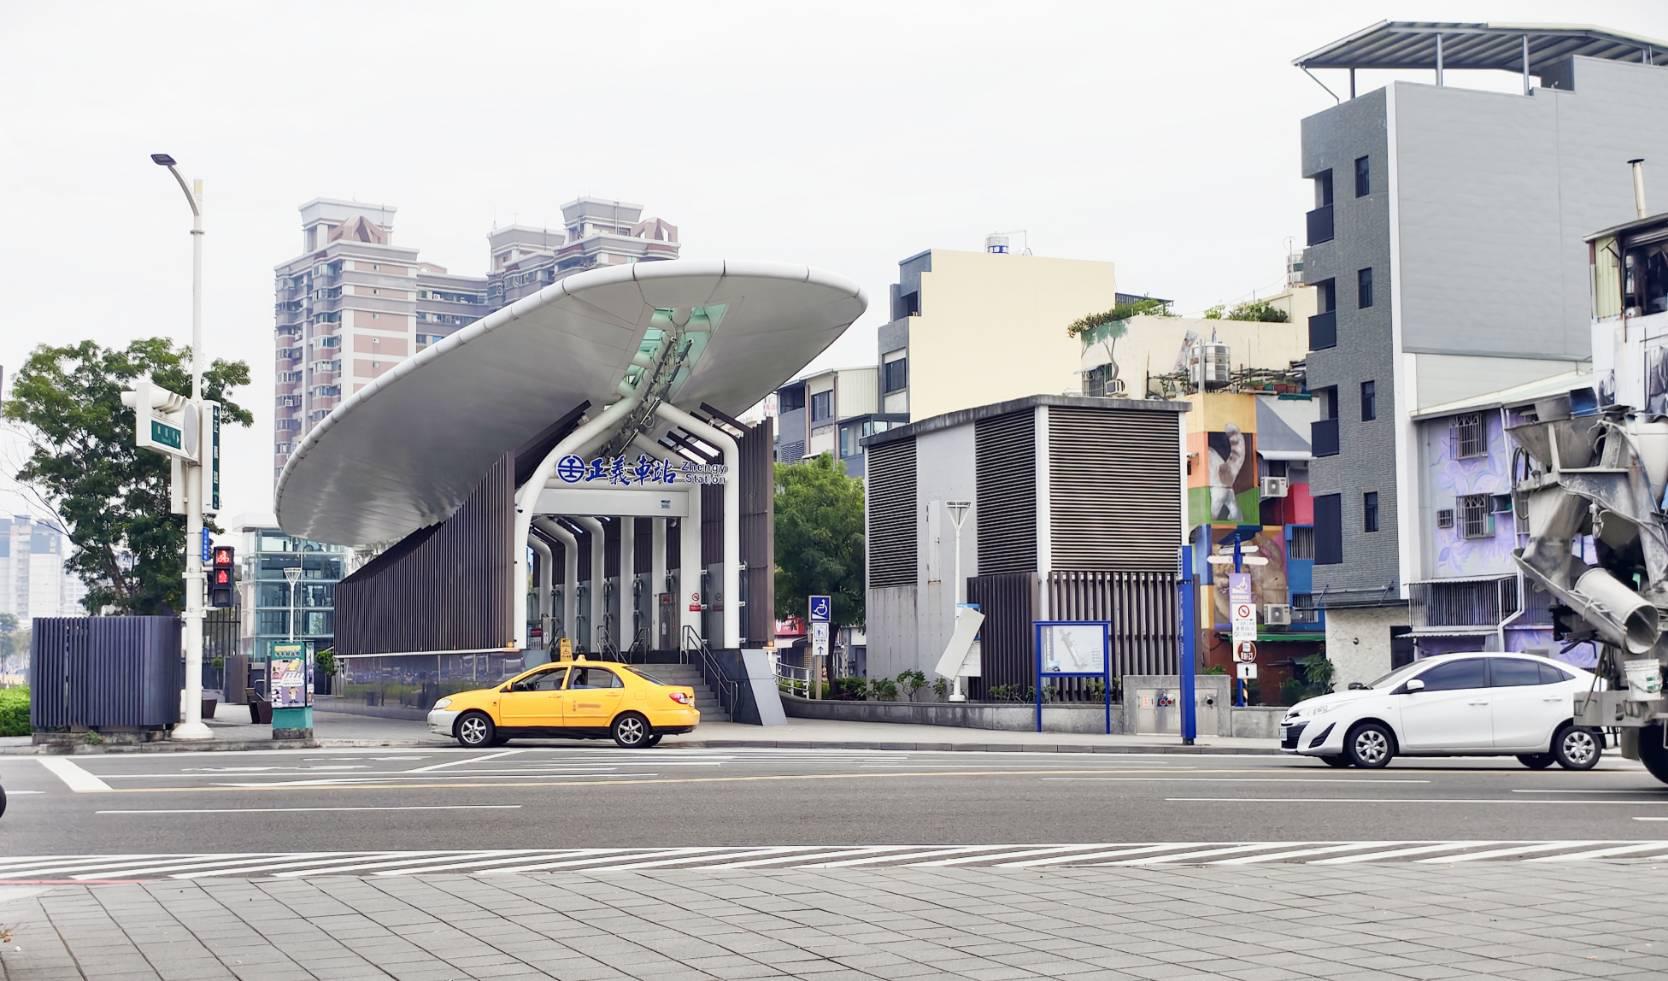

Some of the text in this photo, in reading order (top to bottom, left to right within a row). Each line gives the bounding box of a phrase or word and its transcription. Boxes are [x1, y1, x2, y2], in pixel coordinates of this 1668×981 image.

[585, 454, 677, 486] 正義車站
[685, 473, 726, 484] Station
